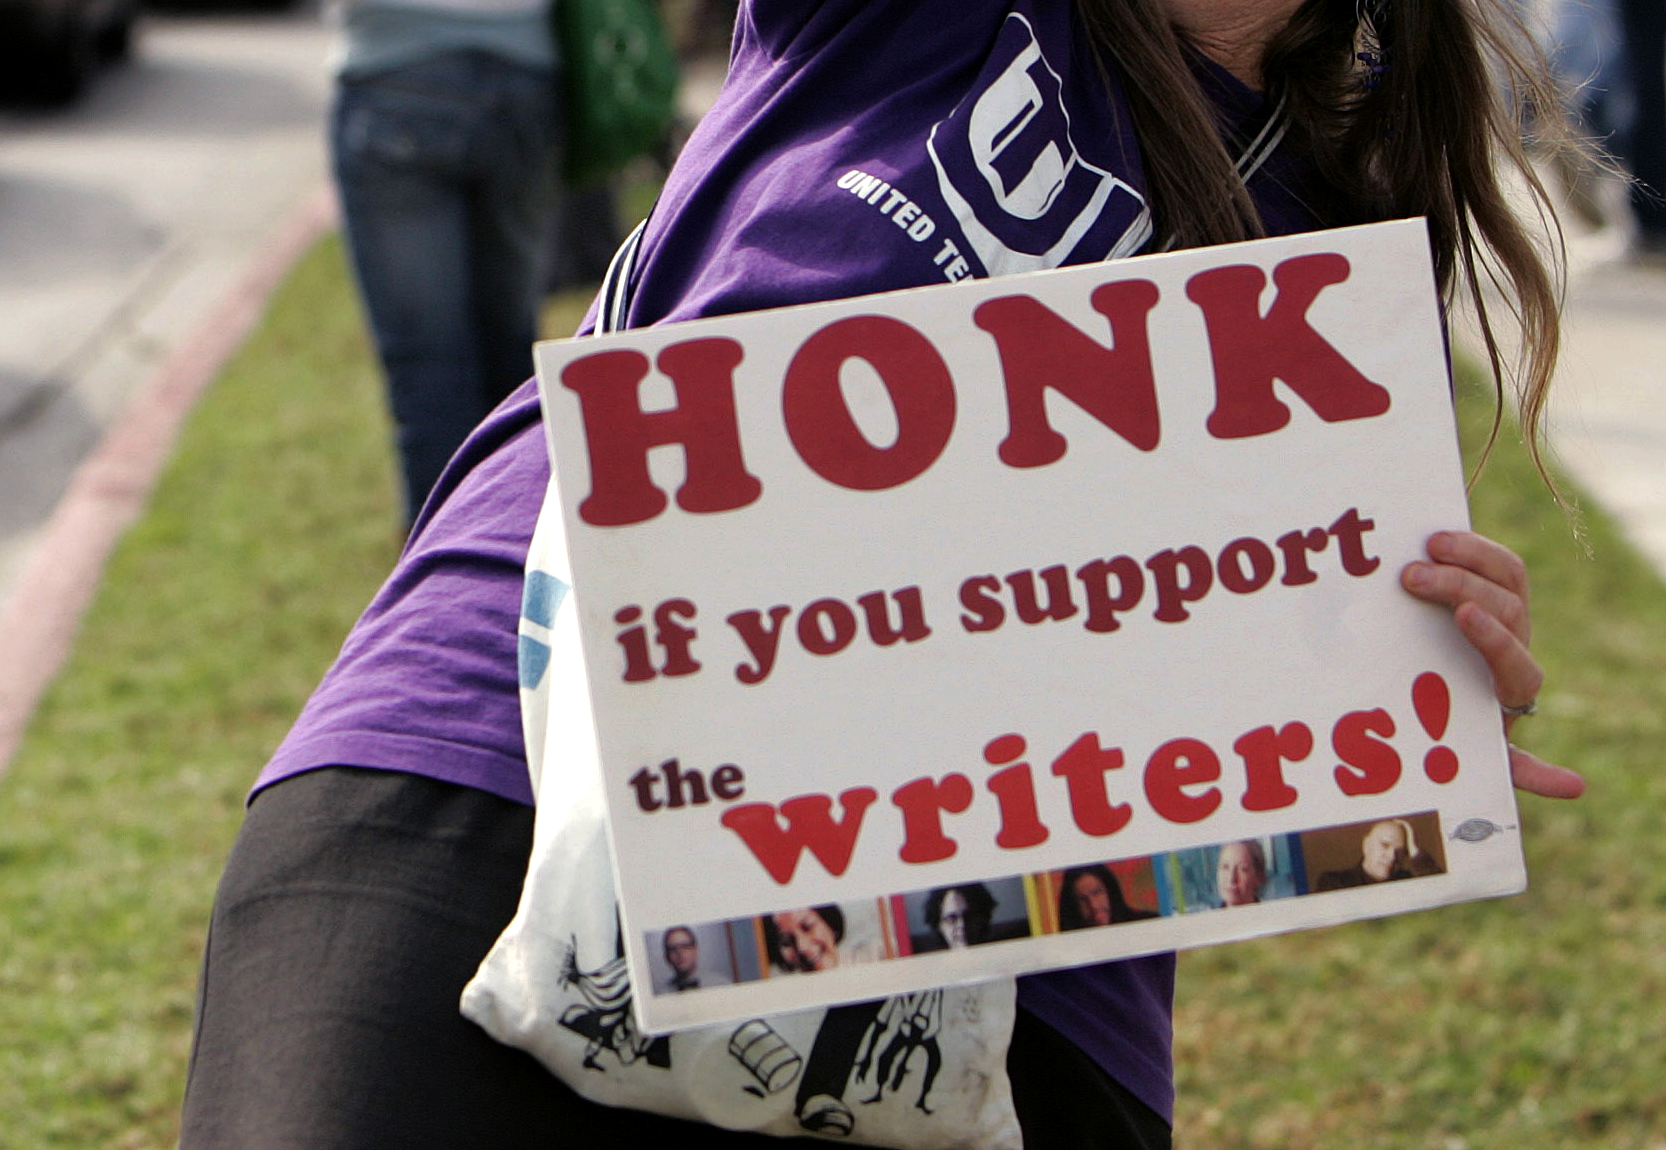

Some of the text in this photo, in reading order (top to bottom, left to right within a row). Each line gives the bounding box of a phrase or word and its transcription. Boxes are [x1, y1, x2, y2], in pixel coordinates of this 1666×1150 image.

[836, 169, 975, 284] UNITED TE
[560, 252, 1391, 527] HONK
[614, 507, 1381, 685] if you support
[629, 671, 1459, 886] the writers!
